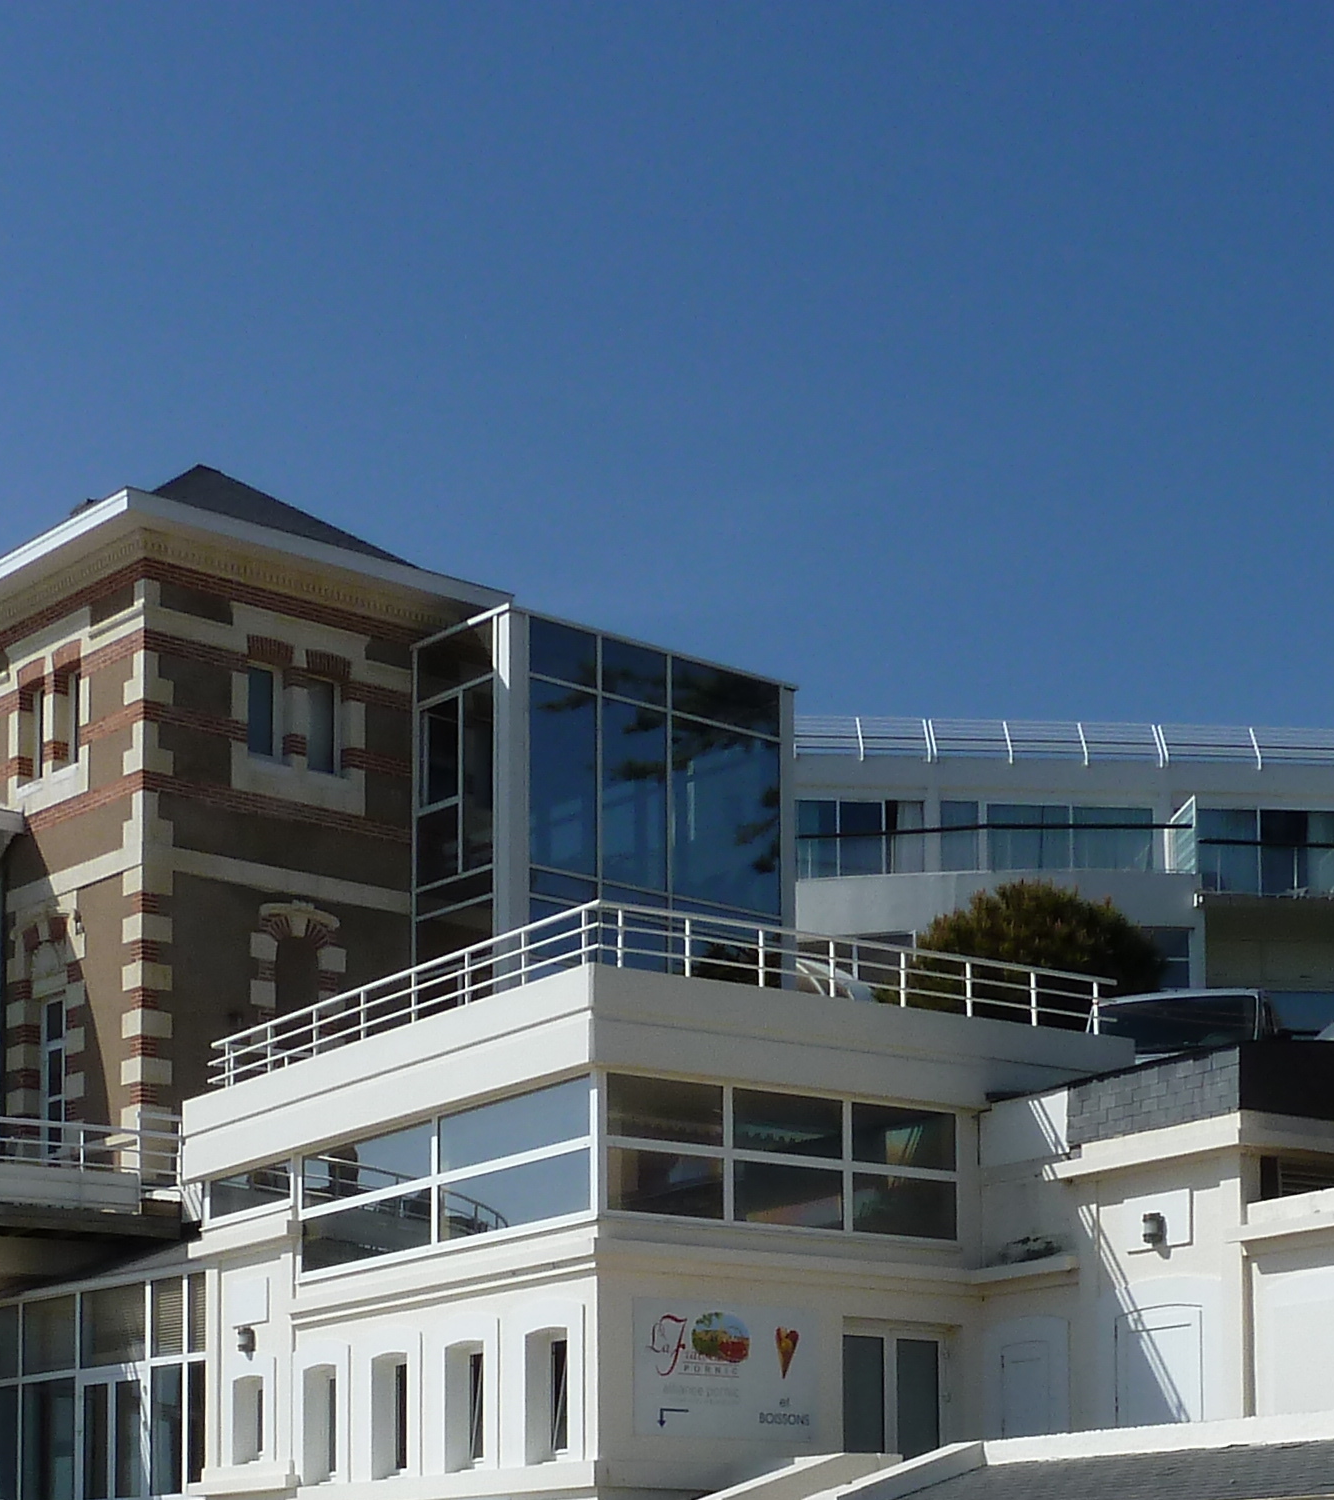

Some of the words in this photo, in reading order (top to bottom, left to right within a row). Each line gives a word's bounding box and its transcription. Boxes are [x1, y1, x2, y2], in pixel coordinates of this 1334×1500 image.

[683, 1364, 739, 1376] PORNIC
[779, 1398, 790, 1407] et
[758, 1412, 810, 1427] BOISSONS
